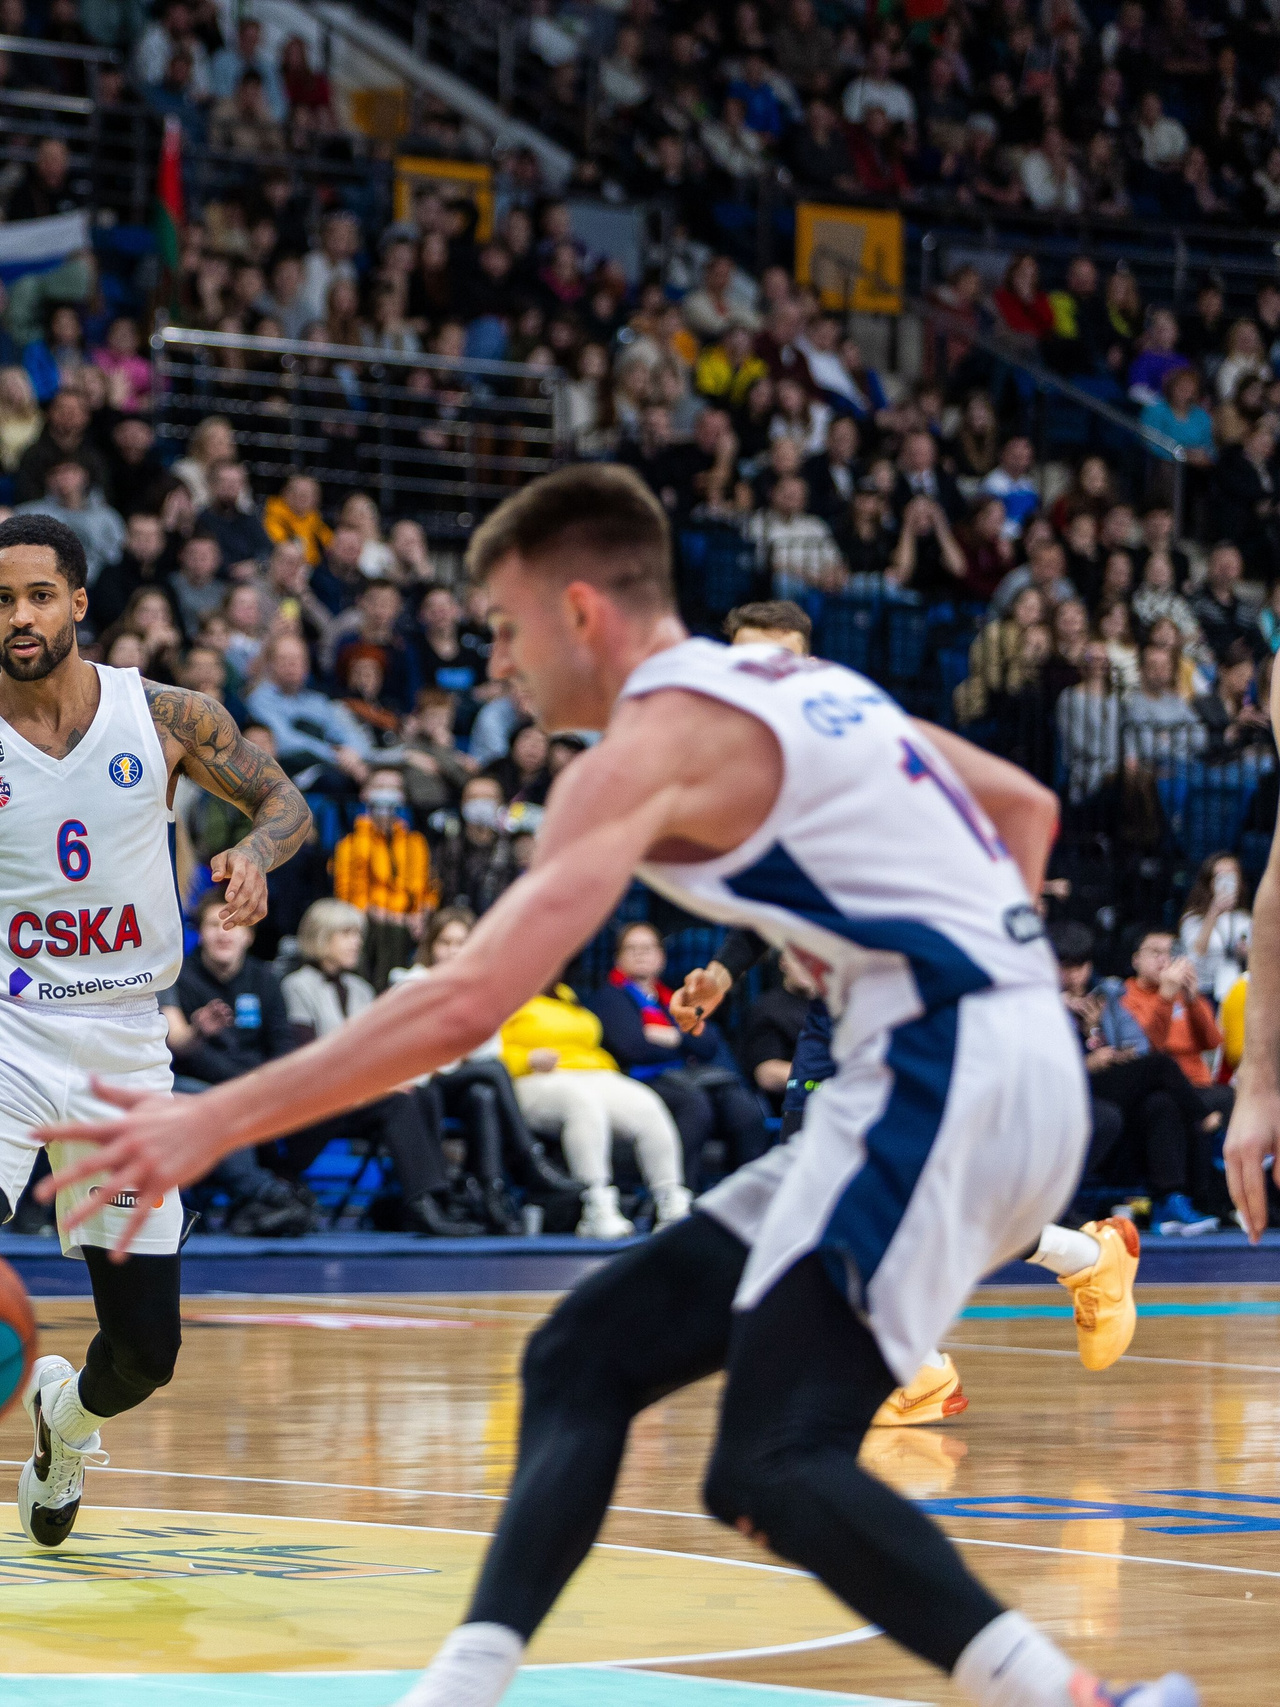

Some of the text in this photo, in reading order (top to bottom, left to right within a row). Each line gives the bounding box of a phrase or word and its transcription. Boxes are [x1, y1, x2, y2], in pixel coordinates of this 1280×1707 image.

[56, 818, 91, 883] 6
[8, 903, 142, 960] CSKA
[38, 971, 153, 1000] Rostelecom
